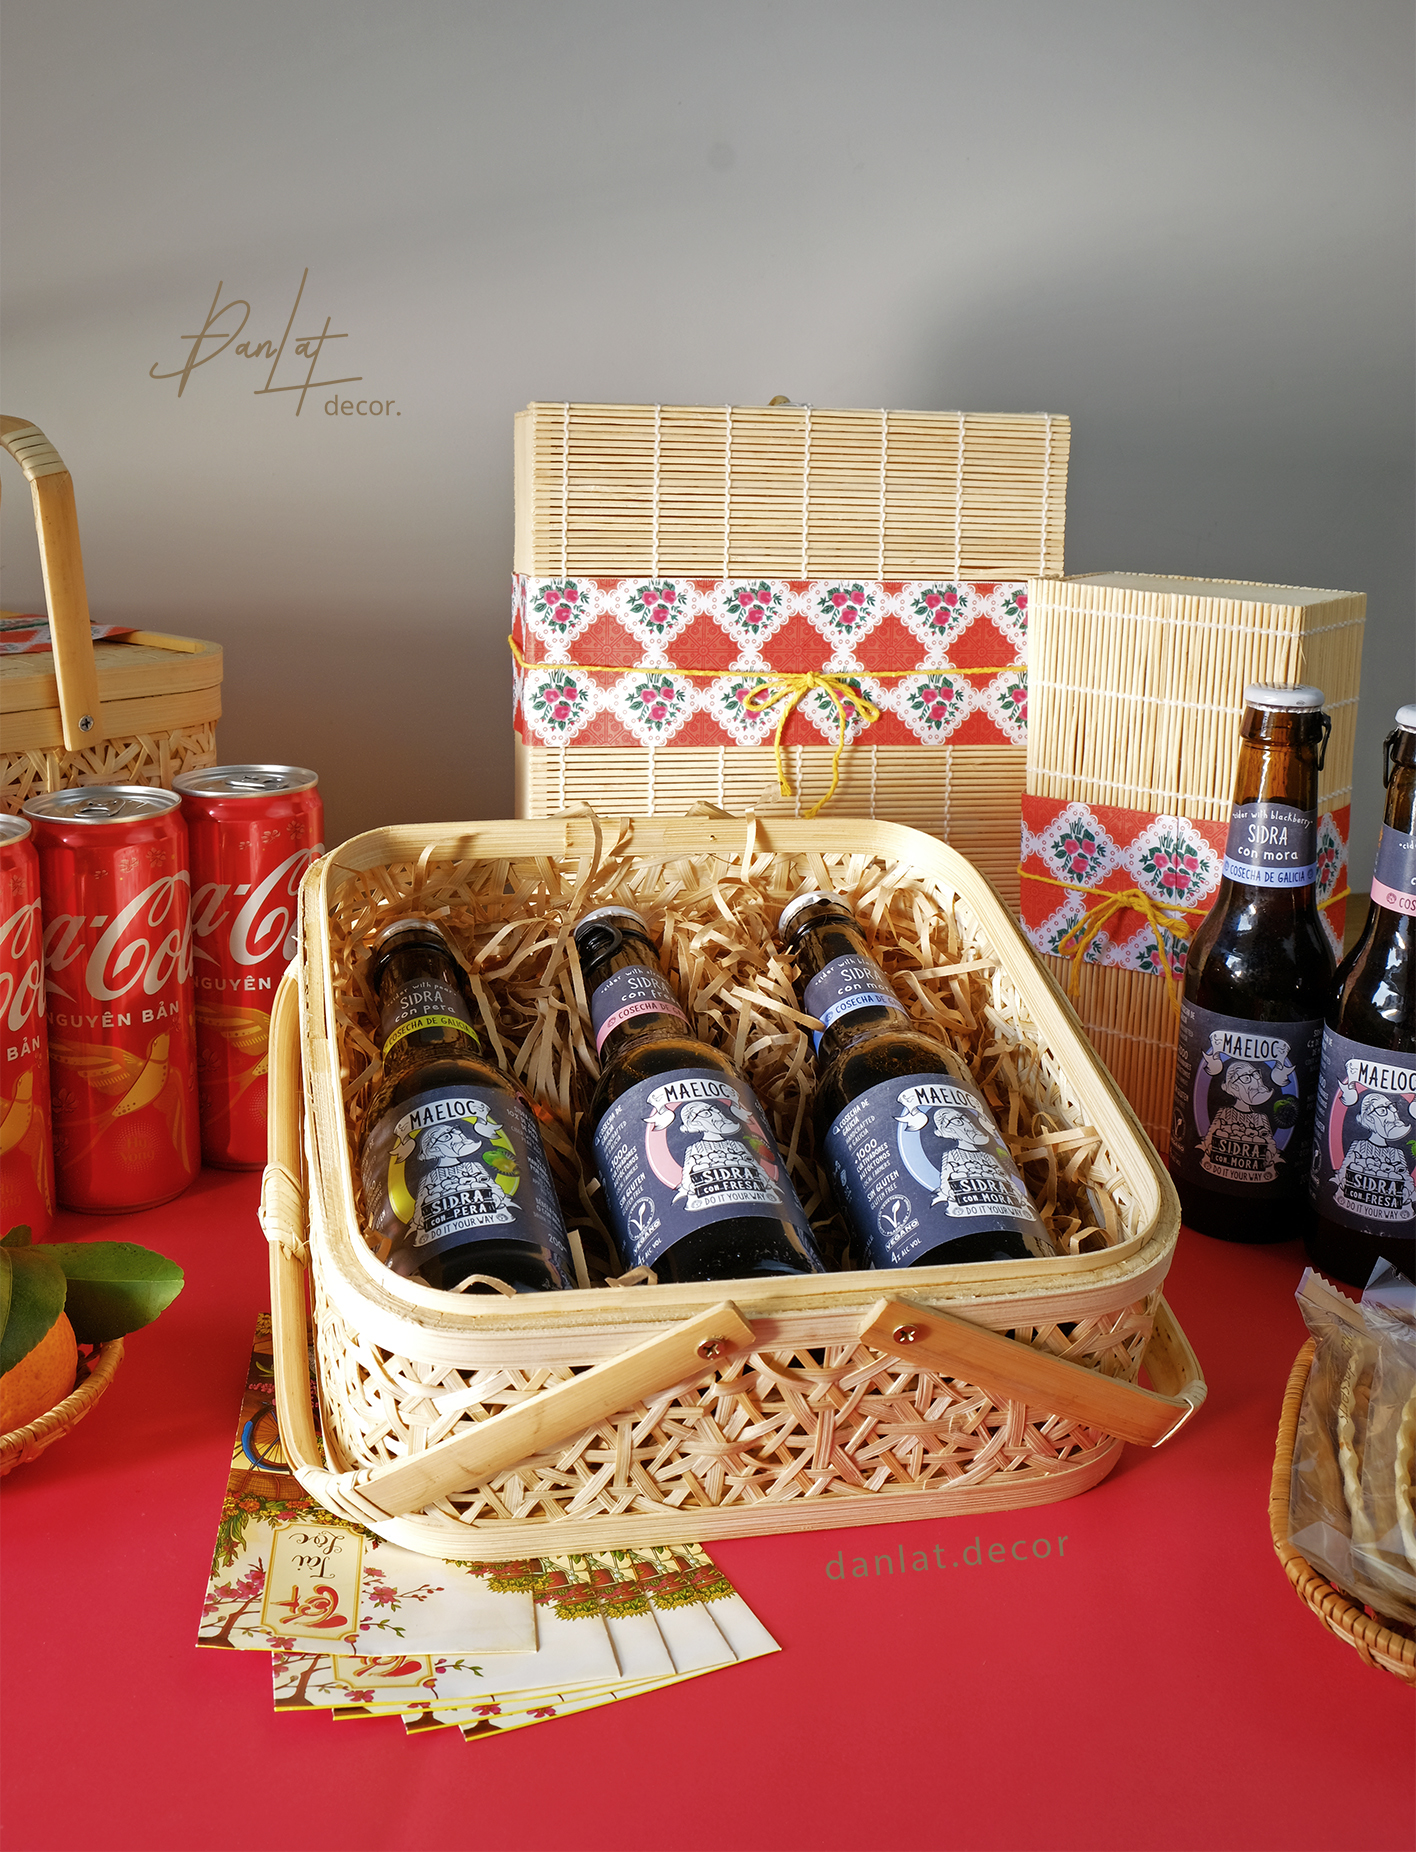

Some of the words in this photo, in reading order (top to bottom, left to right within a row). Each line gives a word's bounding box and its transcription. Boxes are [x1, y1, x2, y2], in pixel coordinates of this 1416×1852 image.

[1251, 810, 1268, 819] with
[1248, 824, 1288, 846] SIDRA
[1238, 846, 1258, 859] con
[1263, 851, 1299, 861] mora
[1230, 864, 1261, 881] COSECHA
[1264, 872, 1275, 882] DE
[1278, 871, 1306, 883] GALICIA
[841, 967, 884, 983] SIDRA
[627, 977, 670, 994] SIDRA
[837, 983, 861, 995] con
[400, 990, 443, 1010] SIDRA
[621, 991, 646, 1002] con
[835, 995, 874, 1013] COSECHA
[142, 1000, 180, 1024] BẢN
[395, 1008, 417, 1023] con
[423, 1005, 456, 1014] pera
[618, 1002, 658, 1019] COSECHA
[389, 1020, 423, 1045] COSECHA
[426, 1017, 438, 1025] DE
[7, 1035, 40, 1062] BẢN
[1222, 1033, 1280, 1059] MAELOC
[664, 1081, 730, 1102] MAELOC
[914, 1088, 977, 1109] MAELOC
[409, 1100, 477, 1130] MAELOC
[839, 1104, 862, 1129] COSECHA
[860, 1098, 870, 1109] DE
[842, 1116, 860, 1136] GALICIA
[857, 1142, 888, 1174] CULTIVADORES
[1218, 1139, 1260, 1158] SIDRA
[1230, 1157, 1259, 1169] MORA
[702, 1167, 754, 1183] SIDRA
[875, 1169, 899, 1192] GLUTEN
[1213, 1165, 1221, 1174] DO
[1223, 1168, 1229, 1176] IT
[1230, 1170, 1247, 1180] YOUR
[1248, 1172, 1262, 1181] WAY
[626, 1172, 646, 1198] GLUTEN
[723, 1180, 760, 1191] FRESA
[959, 1179, 1008, 1195] SIDRA
[1354, 1174, 1396, 1195] SIDRA
[431, 1189, 484, 1215] SIDRA
[704, 1197, 715, 1206] DO
[718, 1194, 725, 1203] IT
[726, 1193, 750, 1201] YOUR
[750, 1192, 766, 1201] WAY
[981, 1193, 1014, 1206] MORA
[1365, 1193, 1397, 1208] FRESA
[453, 1203, 487, 1218] PERA
[966, 1207, 977, 1215] DO
[987, 1206, 1008, 1214] YOUR
[1007, 1208, 1023, 1217] WAY
[1346, 1200, 1355, 1210] DO
[1356, 1204, 1363, 1213] IT
[1364, 1206, 1383, 1218] YOUR
[1384, 1210, 1399, 1219] WAY
[431, 1228, 441, 1239] DO
[444, 1224, 451, 1233] IT
[453, 1217, 476, 1230] YOUR
[476, 1214, 494, 1224] WAY
[885, 1218, 919, 1252] VEGANO
[289, 1530, 345, 1555] Lộc
[292, 1554, 335, 1578] Tài
